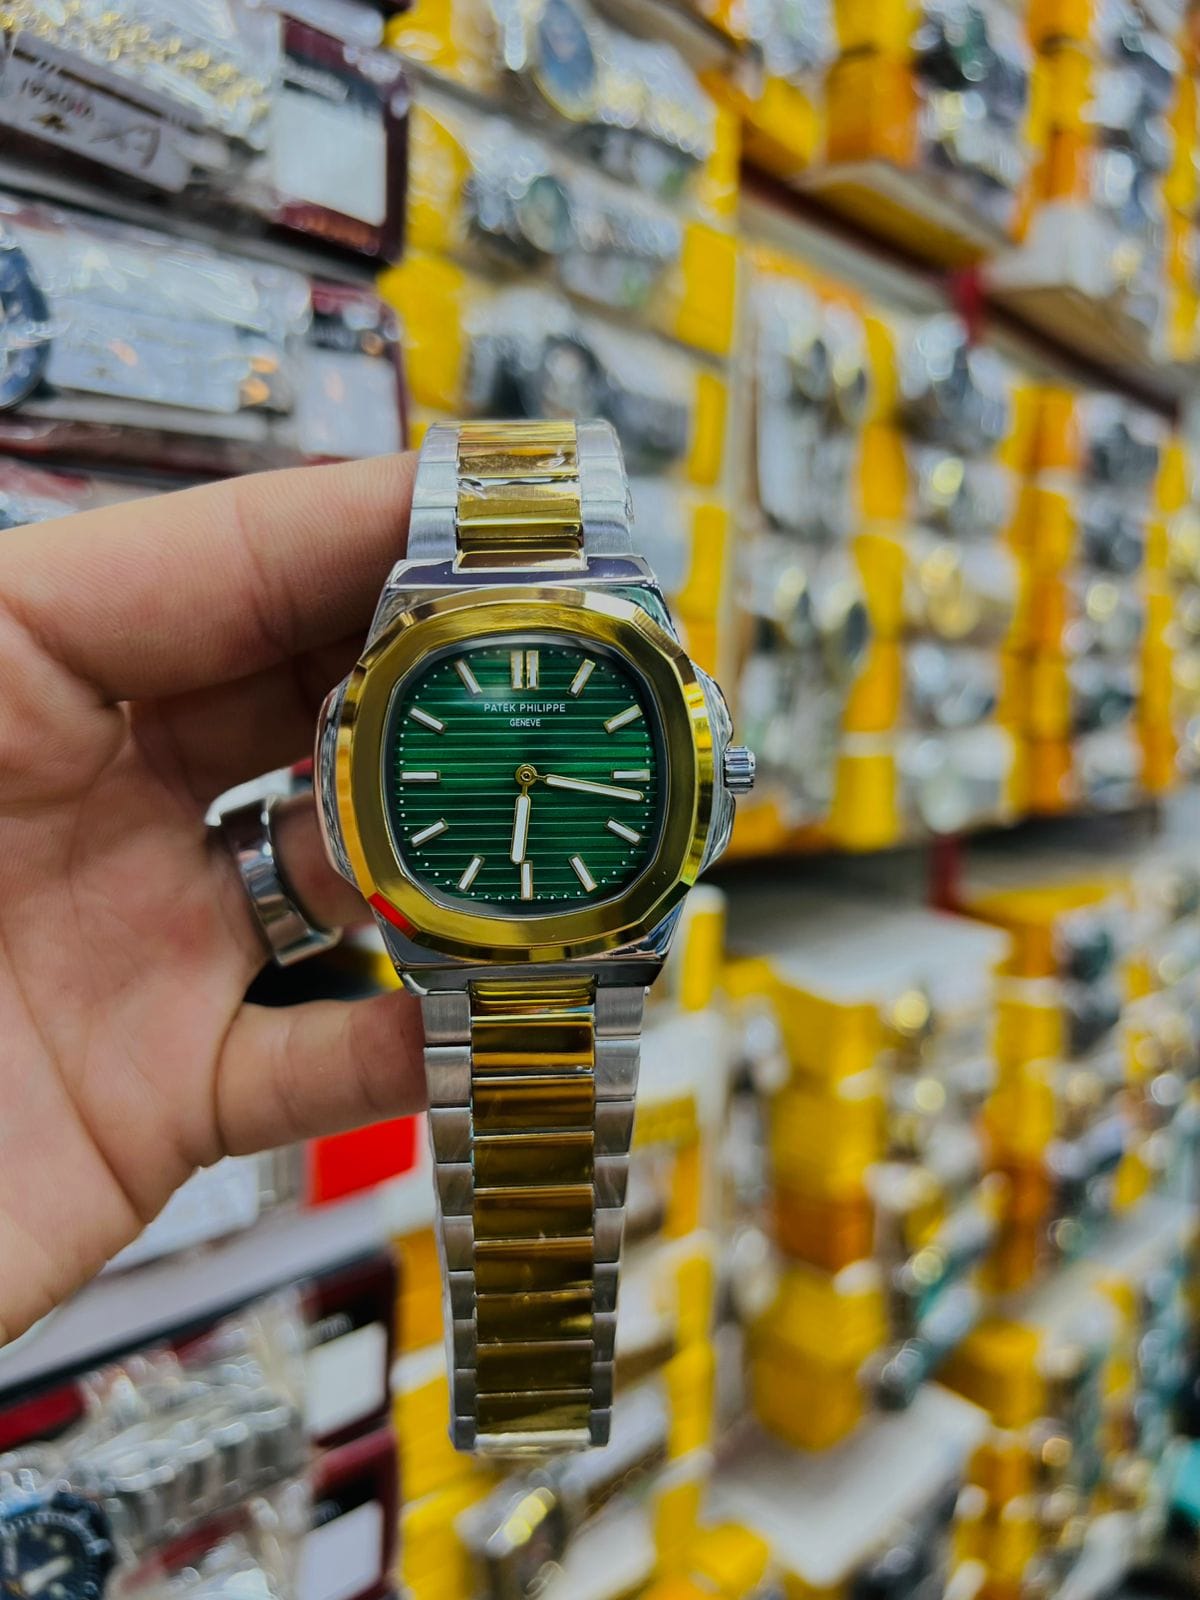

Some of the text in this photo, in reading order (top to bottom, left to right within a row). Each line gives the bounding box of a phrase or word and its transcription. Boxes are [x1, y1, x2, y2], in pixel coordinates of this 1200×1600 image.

[483, 703, 567, 713] PATEK PHILIPPE
[509, 718, 542, 728] GENEVE
